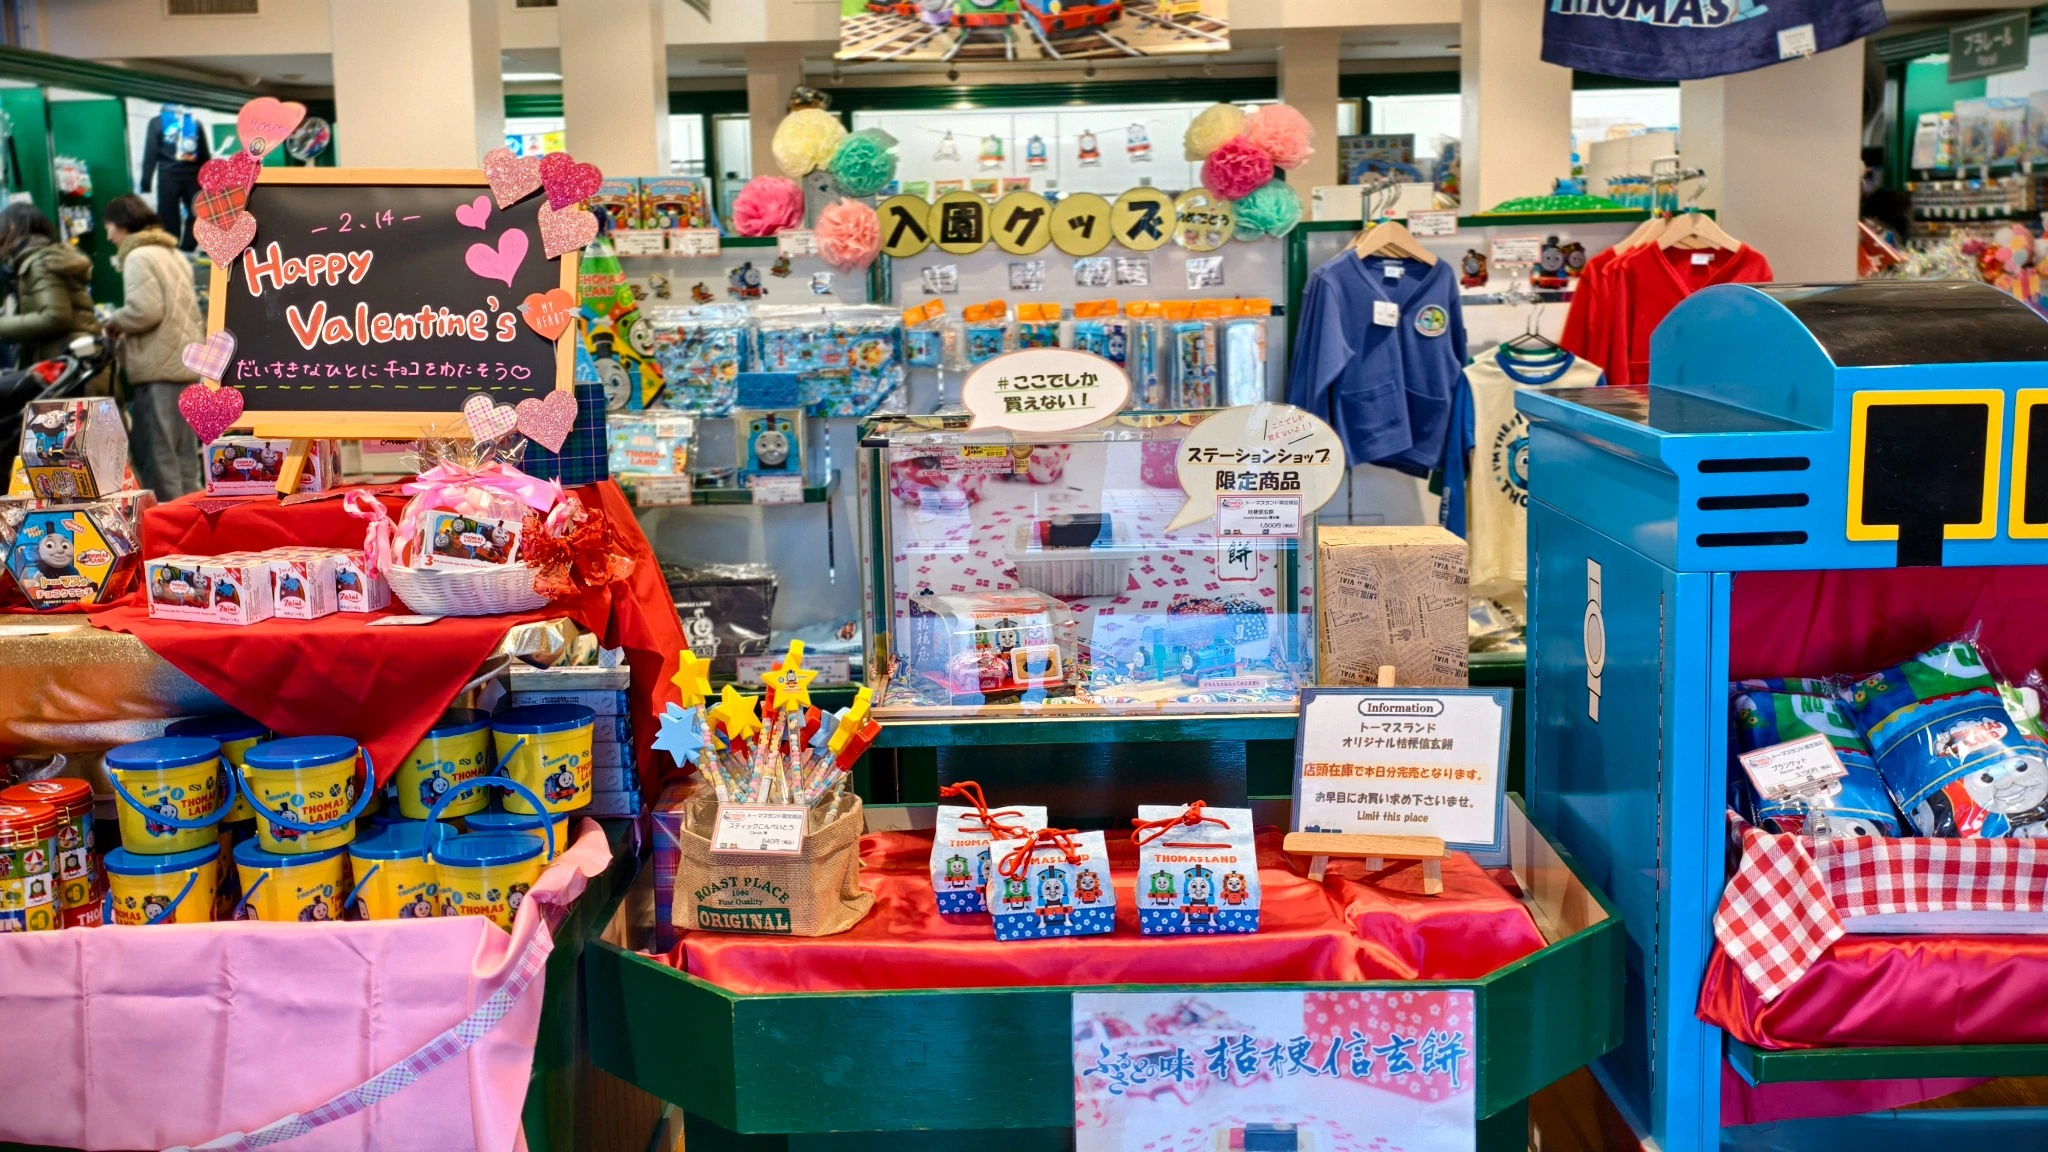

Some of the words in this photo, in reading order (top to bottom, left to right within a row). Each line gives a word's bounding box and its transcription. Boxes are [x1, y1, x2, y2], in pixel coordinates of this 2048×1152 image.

[887, 200, 1164, 249] 入園グッズ
[243, 240, 373, 297] Happy
[541, 301, 554, 313] MY
[286, 295, 518, 350] Valentine's
[535, 312, 565, 330] HEART
[1187, 447, 1331, 464] ステーションショップ
[207, 483, 214, 493] 3
[1215, 470, 1302, 491] 限定商品
[425, 555, 434, 566] 3
[150, 603, 156, 615] 3
[1367, 702, 1434, 713] Information
[1360, 722, 1437, 734] トーマスランド
[1342, 737, 1454, 751] オリジナル桔梗信玄餅
[1303, 763, 1483, 781] 店頭在庫で本日分完売となります。
[301, 797, 344, 815] THOMAS
[1315, 791, 1475, 808] お早目にお買い求め下さいませ。
[188, 801, 213, 817] LAND
[309, 809, 339, 823] LAND
[1357, 811, 1380, 821] Limit
[1383, 812, 1401, 822] this
[1404, 812, 1429, 823] place
[694, 876, 738, 902] ROAST
[743, 877, 790, 904] PLACE
[460, 904, 505, 914] THOMAS
[699, 910, 789, 931] ORIGINAL
[1202, 1029, 1470, 1088] 桔梗信玄餅
